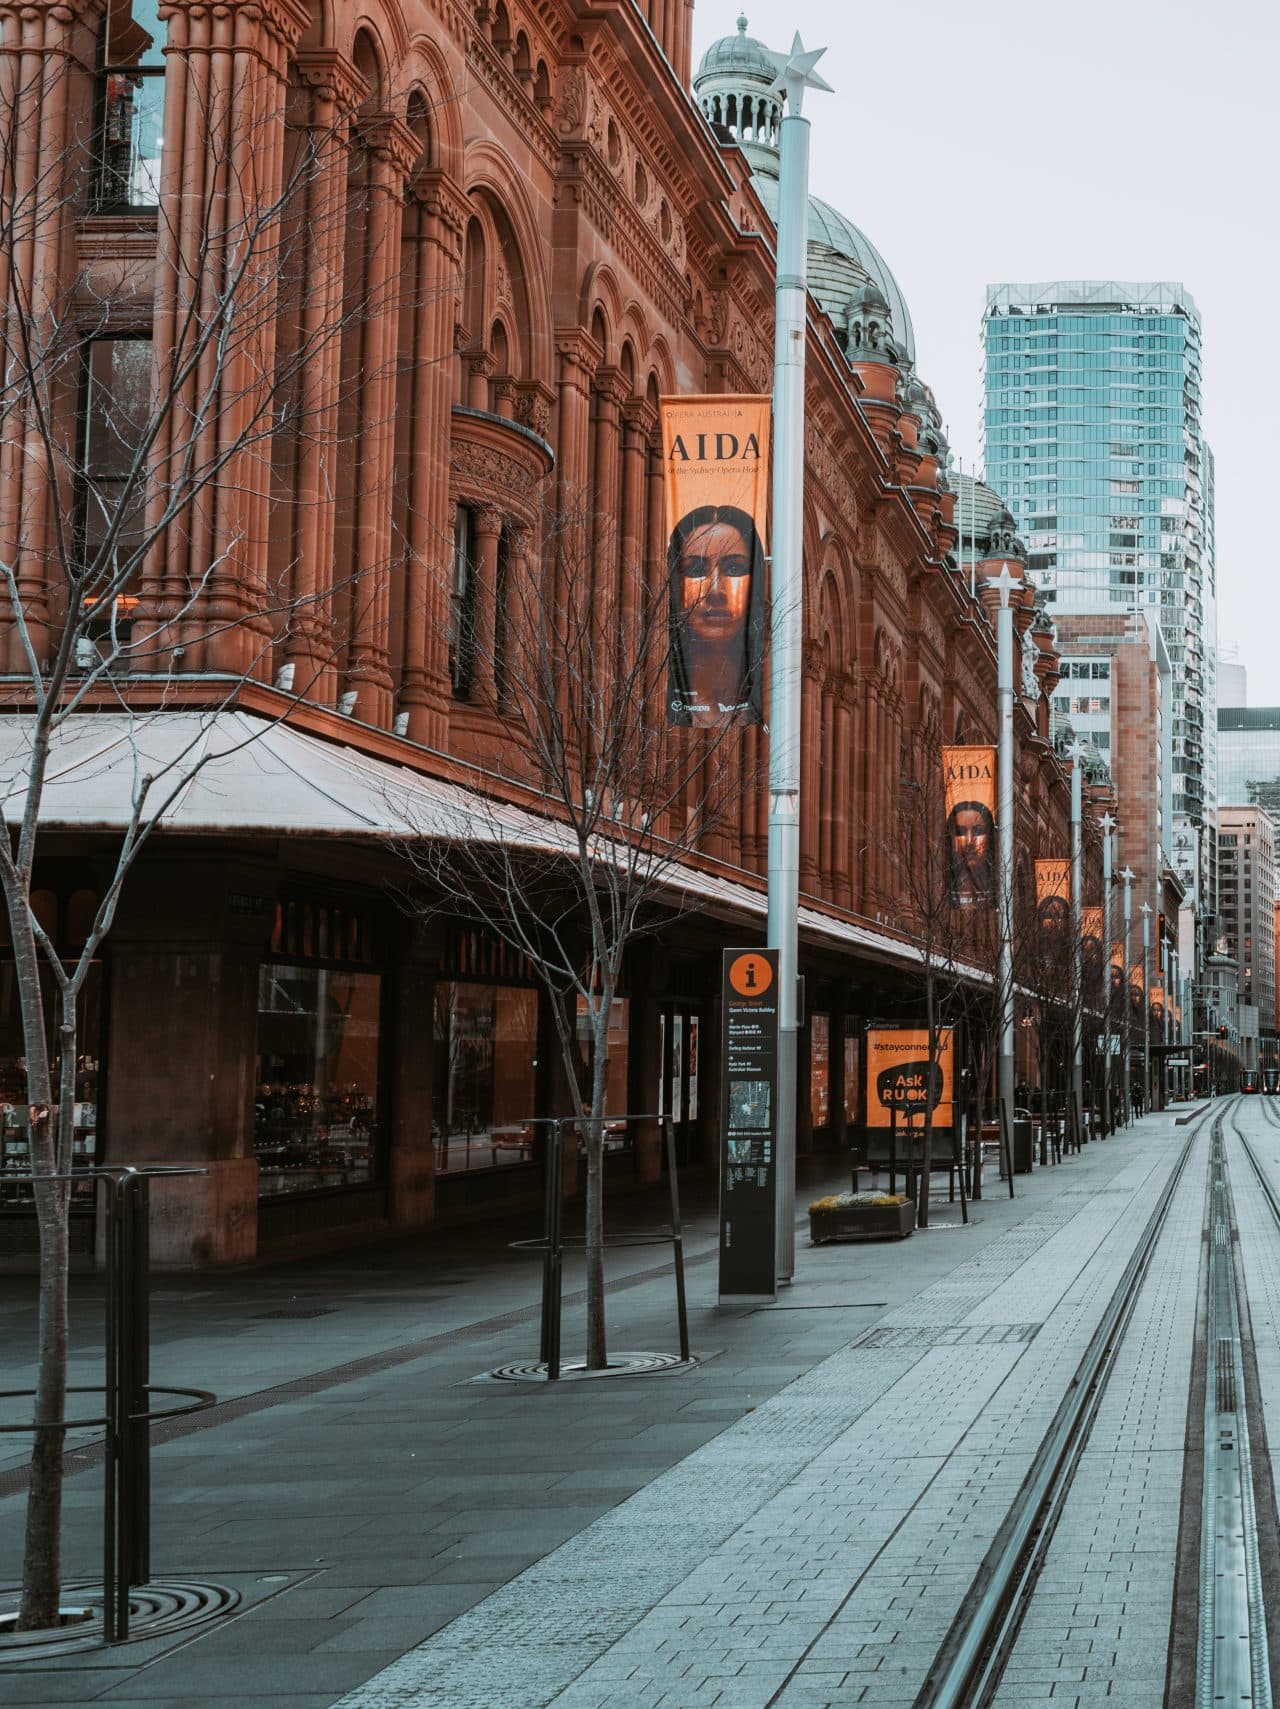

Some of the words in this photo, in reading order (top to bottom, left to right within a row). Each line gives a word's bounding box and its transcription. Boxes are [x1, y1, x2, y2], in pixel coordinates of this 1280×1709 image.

[669, 432, 761, 461] AIDA
[947, 766, 992, 780] AIDA
[896, 1075, 923, 1087] Ask
